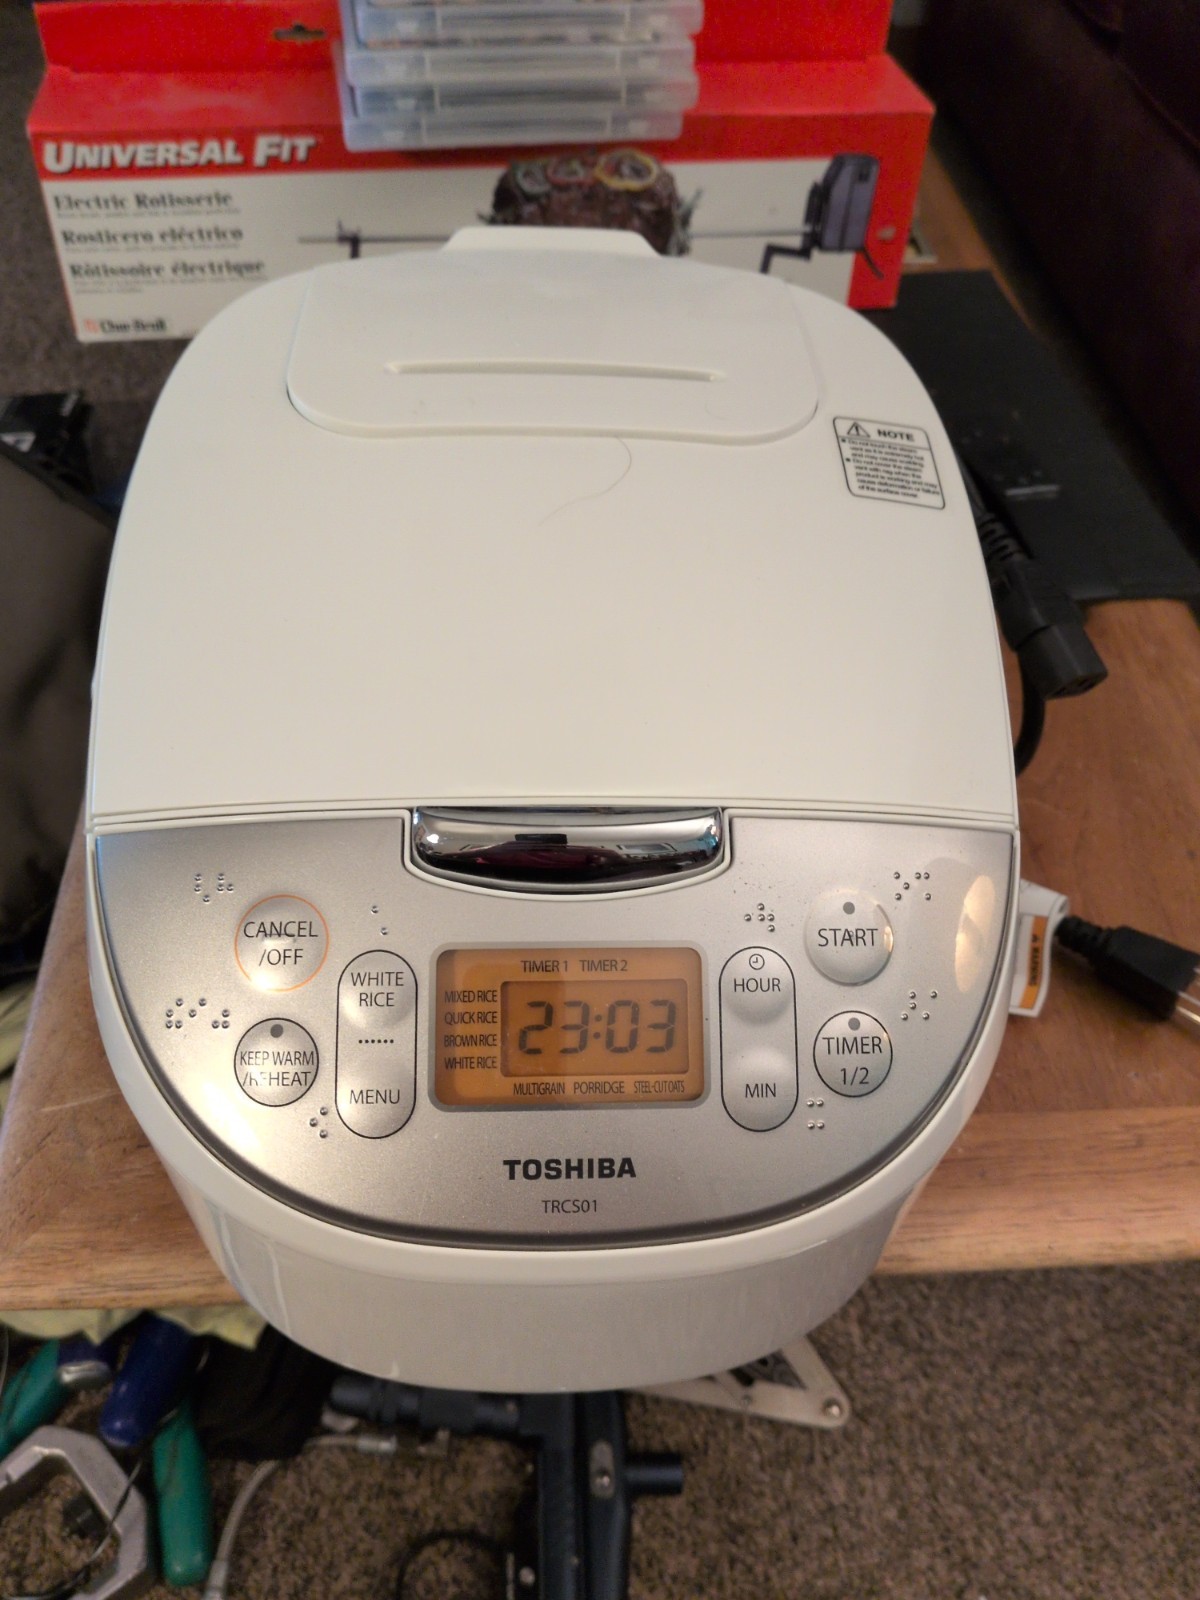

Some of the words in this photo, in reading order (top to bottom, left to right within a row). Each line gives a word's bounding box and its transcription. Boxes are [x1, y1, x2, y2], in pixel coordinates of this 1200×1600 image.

[43, 139, 244, 174] UNIVERSAL
[254, 133, 317, 168] FIT
[53, 193, 126, 210] Electric
[135, 191, 233, 209] Rotisserie
[877, 428, 915, 442] NOTE
[243, 920, 319, 938] CANCEL
[817, 928, 879, 947] START
[258, 948, 304, 967] /OFF
[579, 959, 618, 972] TIMER
[620, 959, 628, 972] 2
[520, 959, 560, 973] TIMER
[562, 960, 568, 972] 1
[350, 971, 405, 987] WHITE
[733, 977, 782, 993] HOUR
[358, 991, 395, 1007] RICE
[444, 990, 476, 1004] MIXED
[477, 989, 498, 1003] RICE
[444, 1011, 476, 1026] QUICK
[476, 1010, 498, 1024] RICE
[518, 1000, 677, 1055] 23:03
[443, 1034, 478, 1047] BROWN
[479, 1033, 498, 1047] RICE
[821, 1035, 883, 1056] TIMER
[239, 1050, 271, 1066] KEEP
[272, 1050, 316, 1067] WARM
[444, 1056, 475, 1070] WHITE
[476, 1055, 498, 1069] RICE
[840, 1066, 870, 1086] 1/2
[513, 1081, 567, 1096] MULTIGRAIN
[573, 1080, 625, 1095] PORRIDGE
[667, 1080, 685, 1093] OATS
[744, 1082, 777, 1098] MIN
[349, 1088, 401, 1106] MENU
[503, 1157, 637, 1181] TOSHIBA
[542, 1199, 597, 1214] TRCS01
